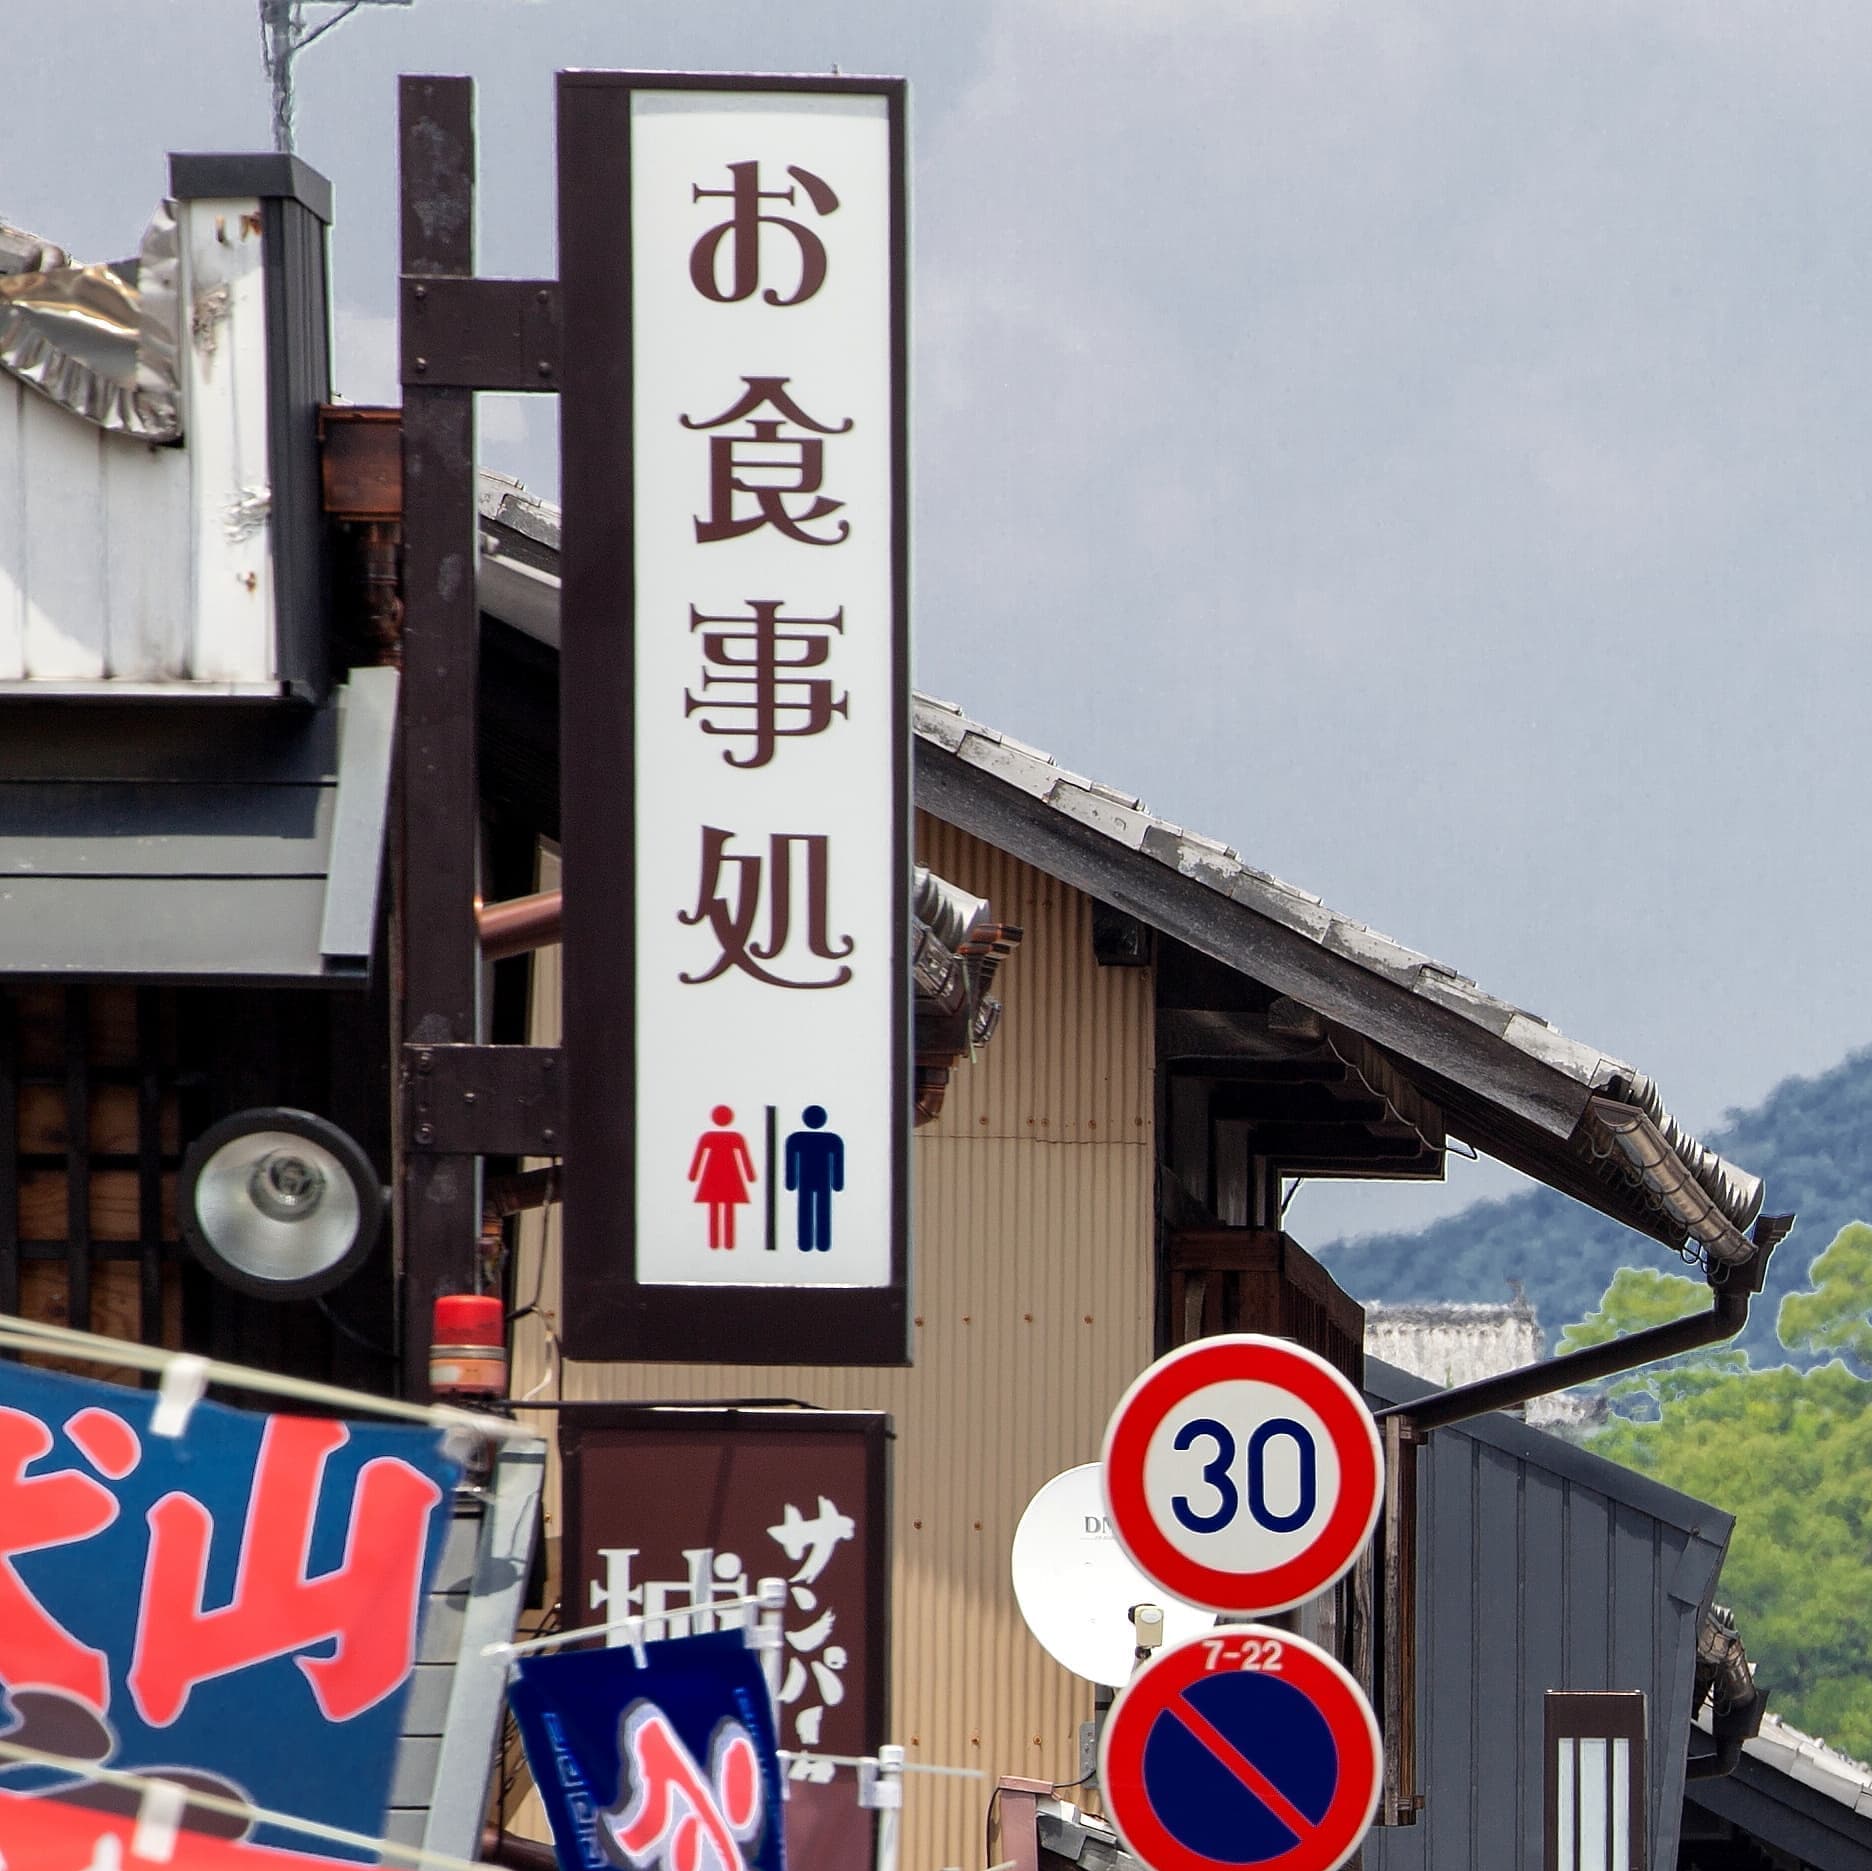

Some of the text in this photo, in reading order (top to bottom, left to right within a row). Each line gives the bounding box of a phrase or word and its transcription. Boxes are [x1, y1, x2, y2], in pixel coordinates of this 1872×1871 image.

[677, 159, 855, 992] お食事処
[1171, 1417, 1318, 1535] 30
[1202, 1639, 1284, 1673] 7-22
